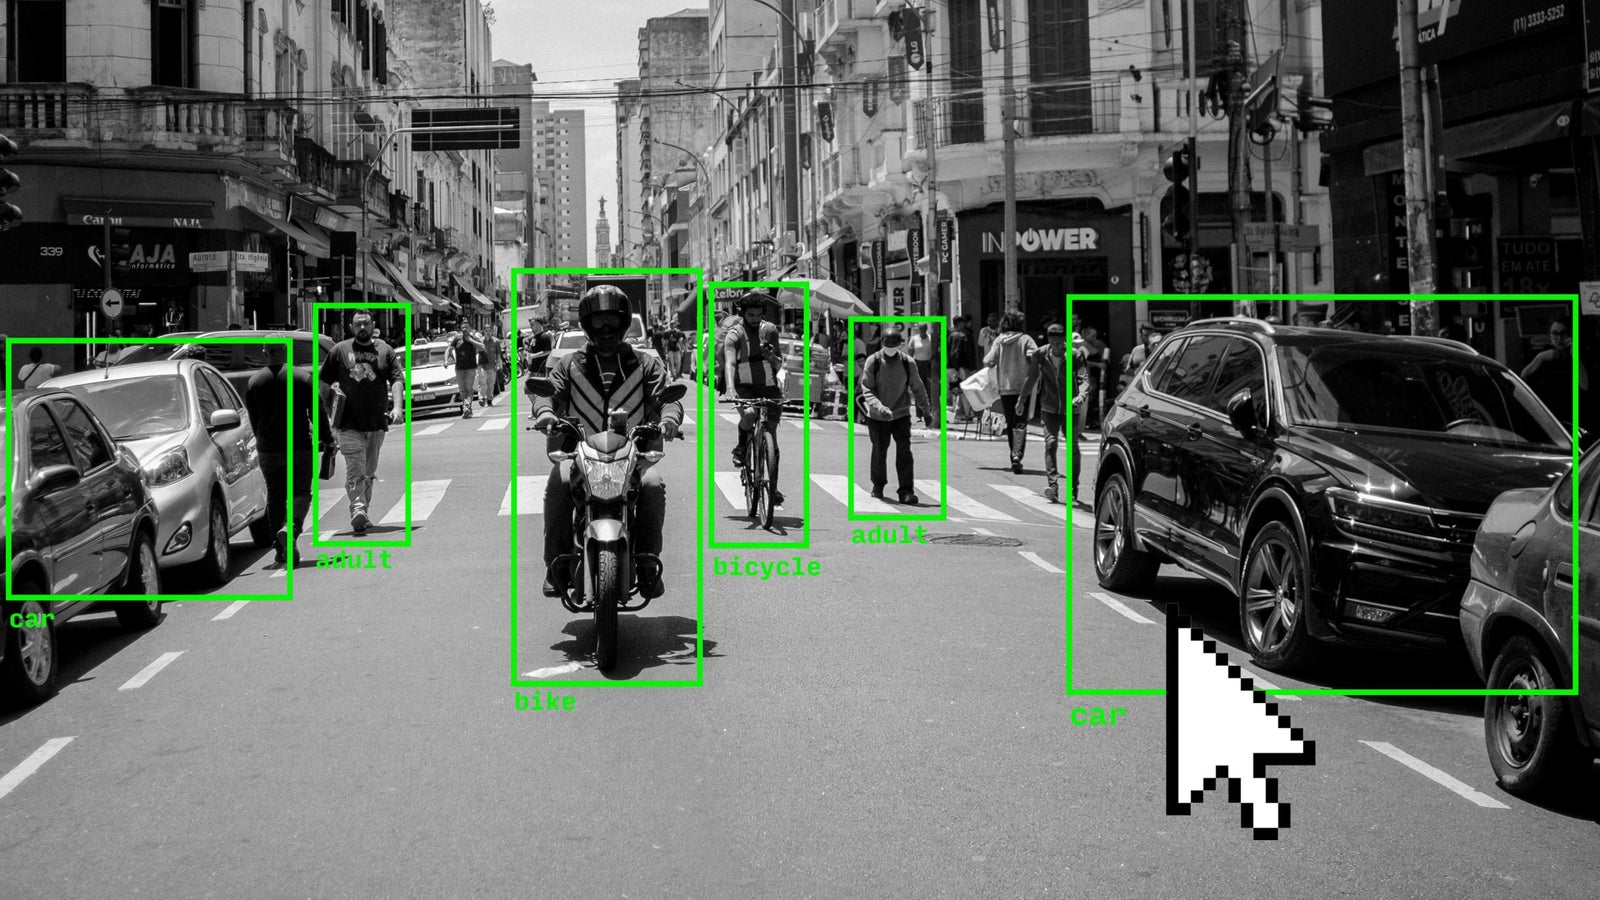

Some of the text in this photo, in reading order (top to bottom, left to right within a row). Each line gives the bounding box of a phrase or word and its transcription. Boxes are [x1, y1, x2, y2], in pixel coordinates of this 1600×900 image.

[1513, 4, 1566, 34] (11) 3333-5252
[910, 40, 918, 53] LG
[941, 221, 949, 263] PC GAMER
[1501, 241, 1551, 255] TUDO
[40, 246, 64, 256] 339
[129, 244, 176, 263] AJA
[192, 252, 217, 262] Aurora
[1501, 260, 1522, 272] EM
